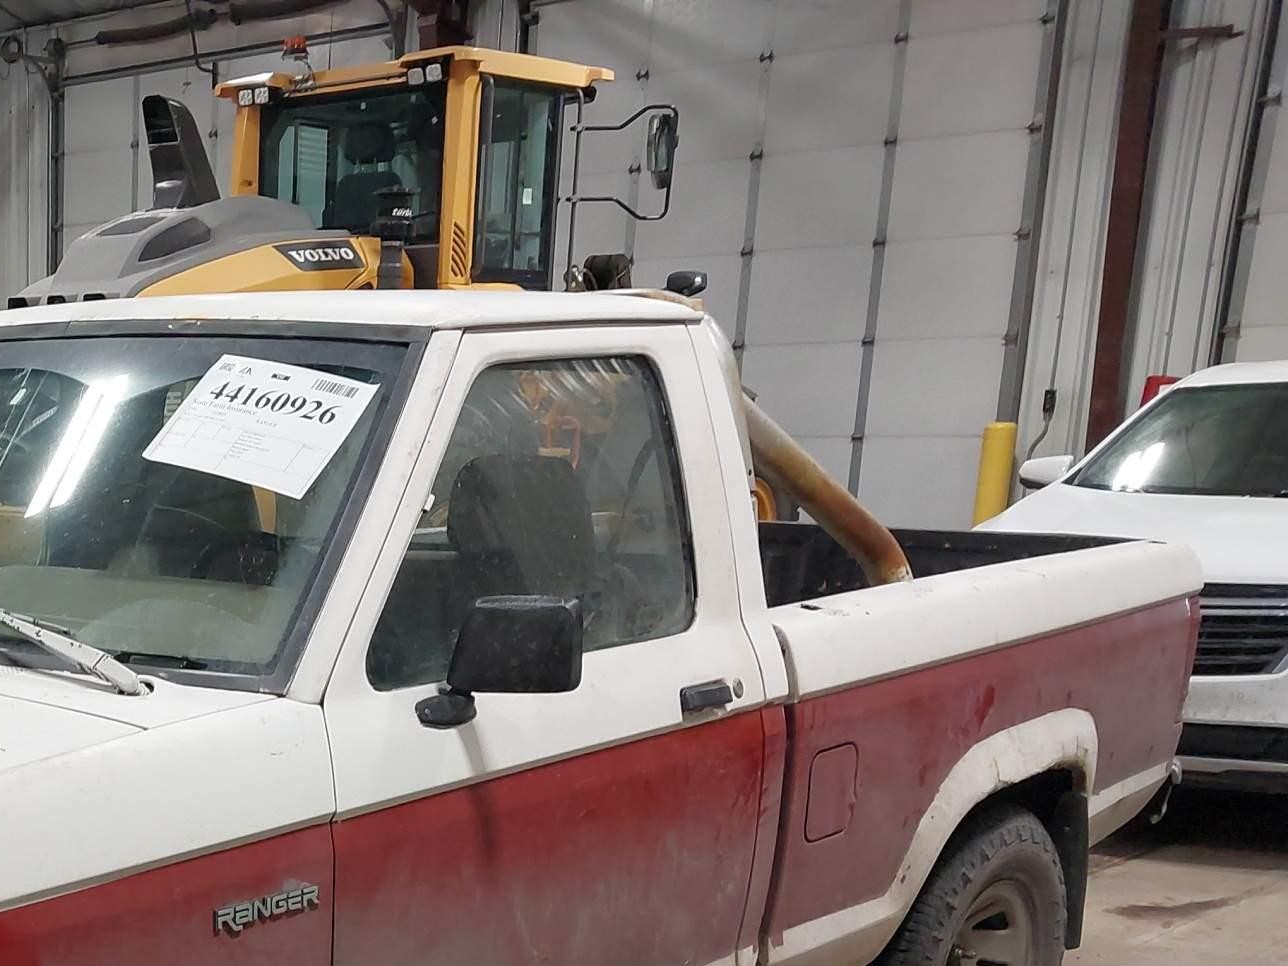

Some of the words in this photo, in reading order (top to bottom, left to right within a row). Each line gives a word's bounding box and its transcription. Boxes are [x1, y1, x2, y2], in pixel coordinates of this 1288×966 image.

[288, 247, 354, 263] VOLVO
[210, 380, 344, 425] 44160926
[215, 885, 321, 933] RANGER
